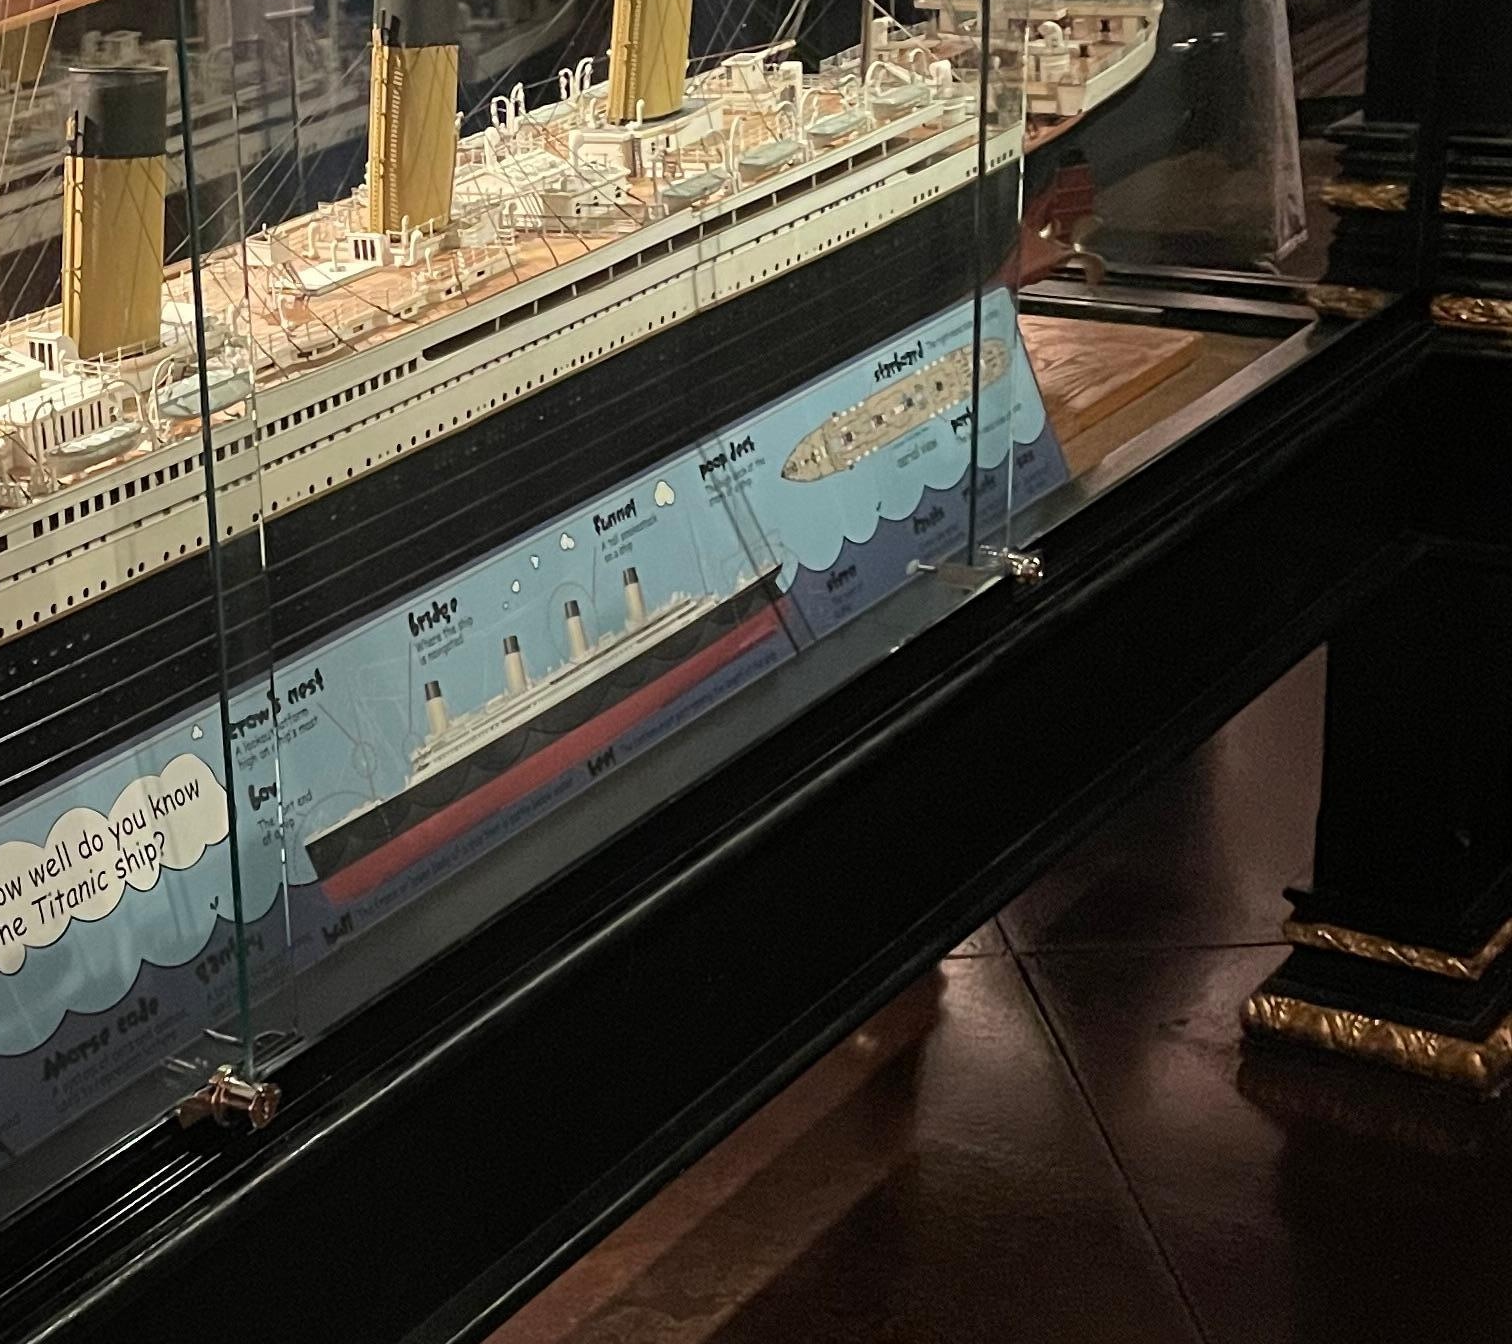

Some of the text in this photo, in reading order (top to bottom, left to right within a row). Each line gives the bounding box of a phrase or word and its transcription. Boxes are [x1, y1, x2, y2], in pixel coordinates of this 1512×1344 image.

[699, 453, 729, 481] poop
[592, 498, 638, 536] funnel
[408, 597, 458, 637] bridge
[442, 626, 457, 638] the
[458, 617, 474, 632] ship
[288, 667, 325, 705] nest
[28, 841, 73, 888] well
[78, 830, 104, 860] do
[108, 809, 147, 851] you
[148, 779, 201, 820] know
[257, 817, 274, 831] The
[31, 868, 109, 925] Titanic
[114, 831, 166, 880] ship?
[41, 996, 159, 1082] Morse code
